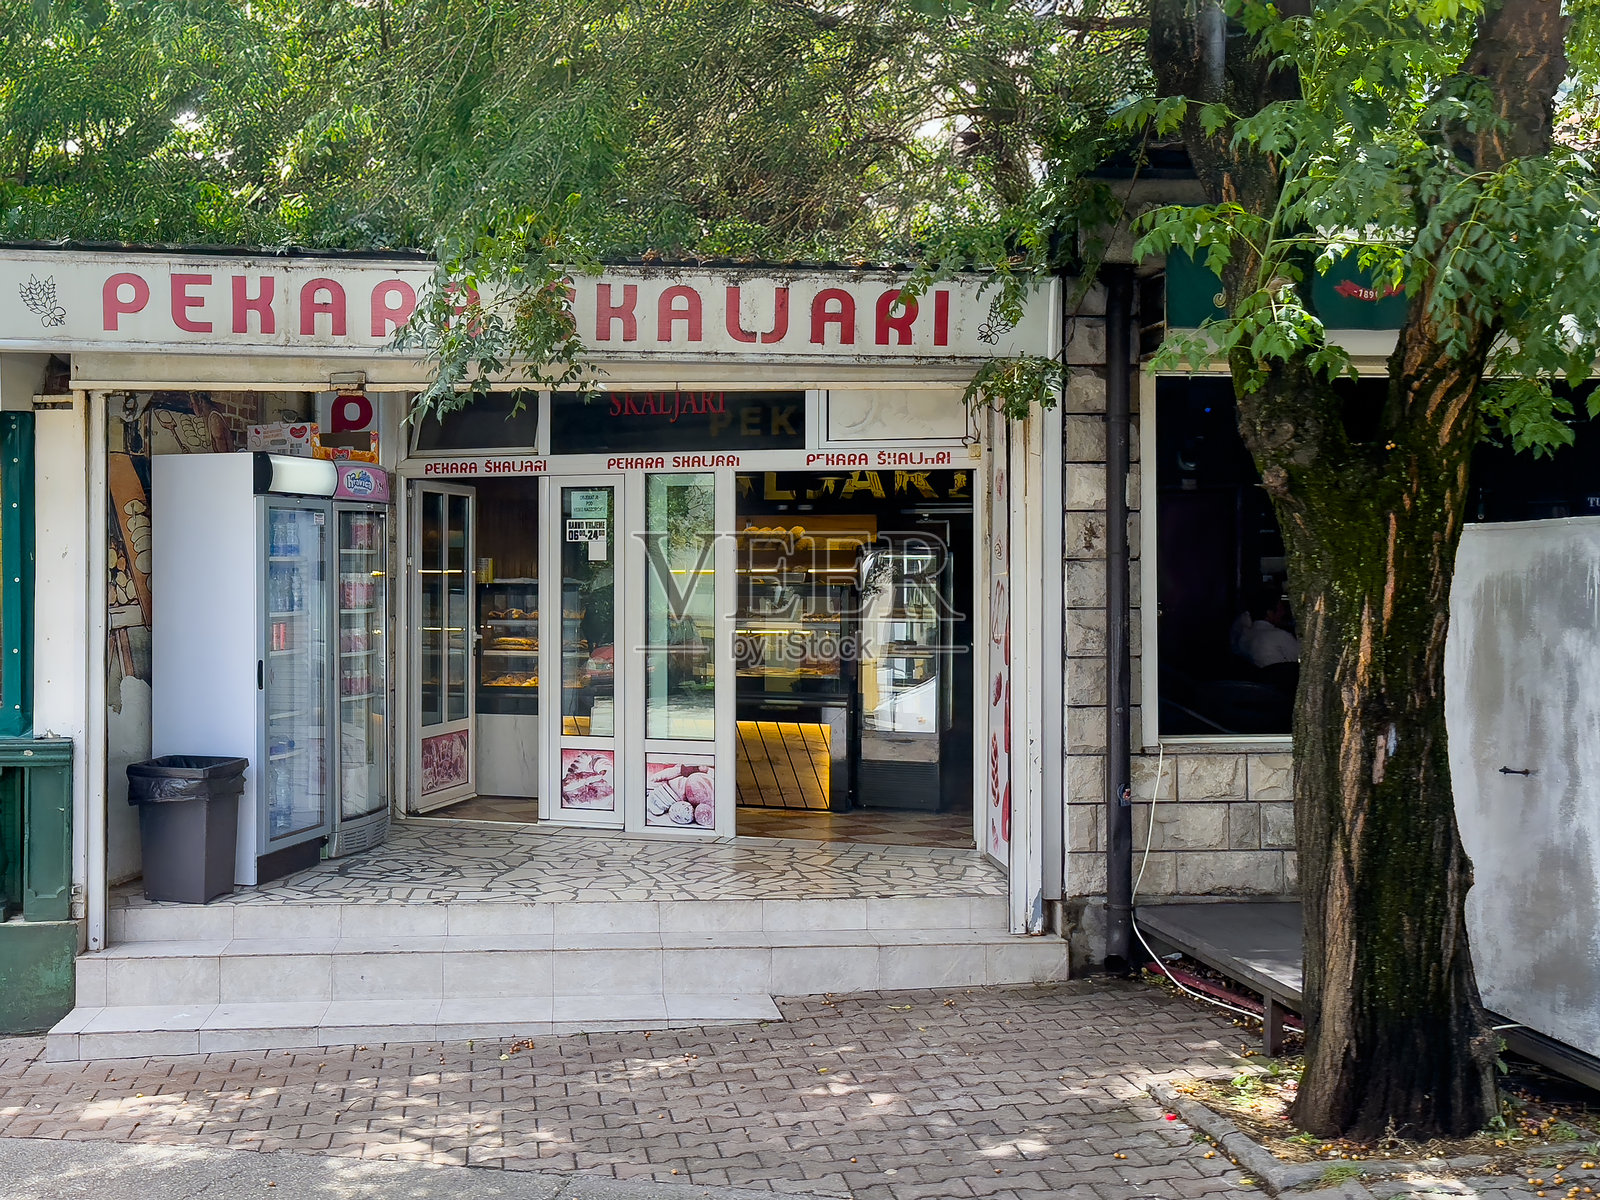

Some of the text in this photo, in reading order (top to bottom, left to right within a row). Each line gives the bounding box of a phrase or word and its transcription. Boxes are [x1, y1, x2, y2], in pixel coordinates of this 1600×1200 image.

[1354, 289, 1386, 300] -189-
[102, 272, 481, 340] PEKARA
[424, 462, 478, 475] PEKARA
[607, 457, 665, 470] PEKARA
